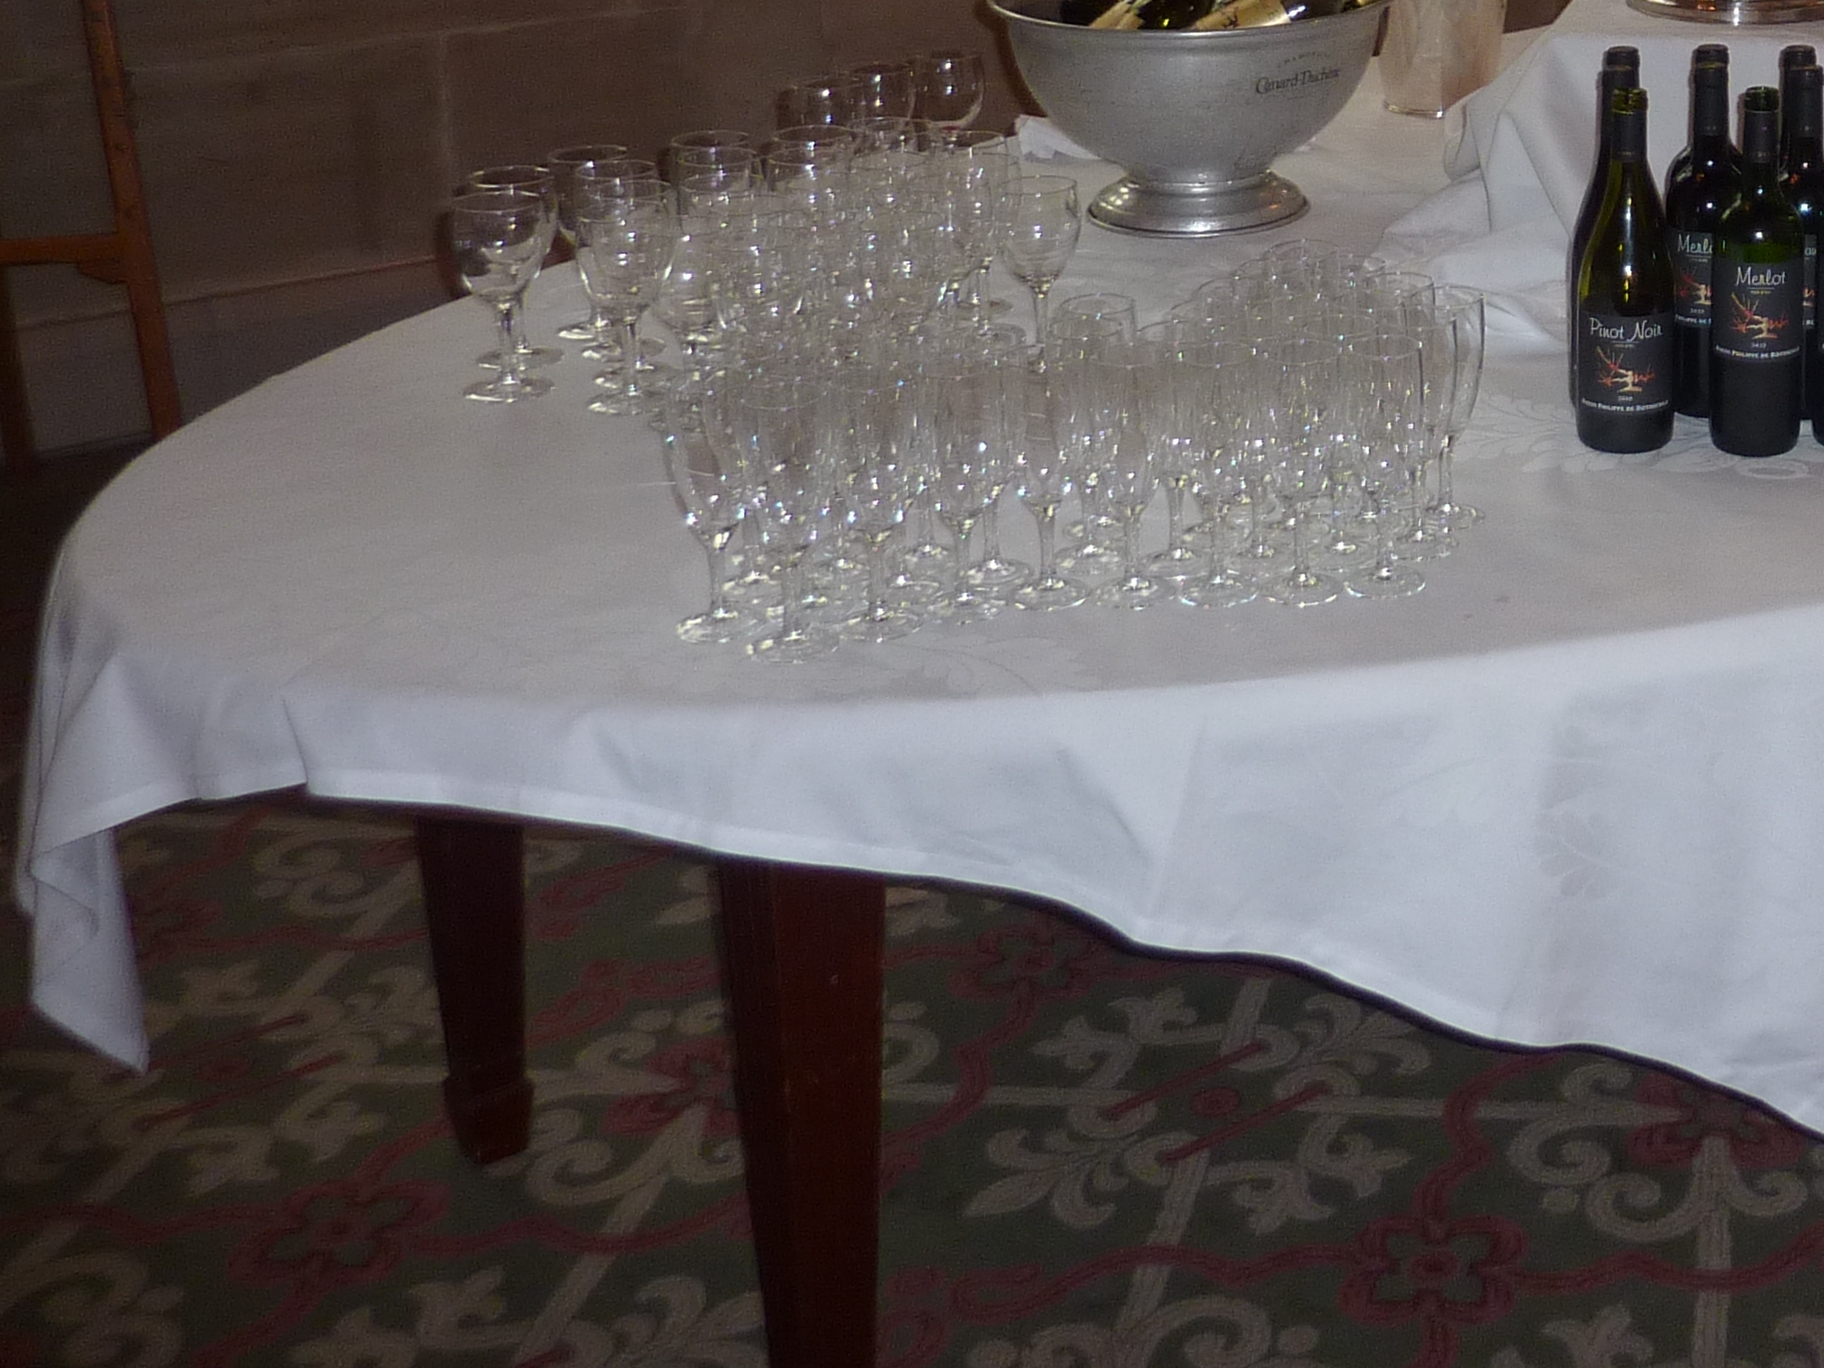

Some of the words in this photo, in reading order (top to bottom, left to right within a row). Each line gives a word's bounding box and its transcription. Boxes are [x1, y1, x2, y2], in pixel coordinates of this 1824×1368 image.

[1734, 266, 1786, 287] Merlot
[1588, 316, 1625, 340] Pinot
[1626, 319, 1664, 343] Noir
